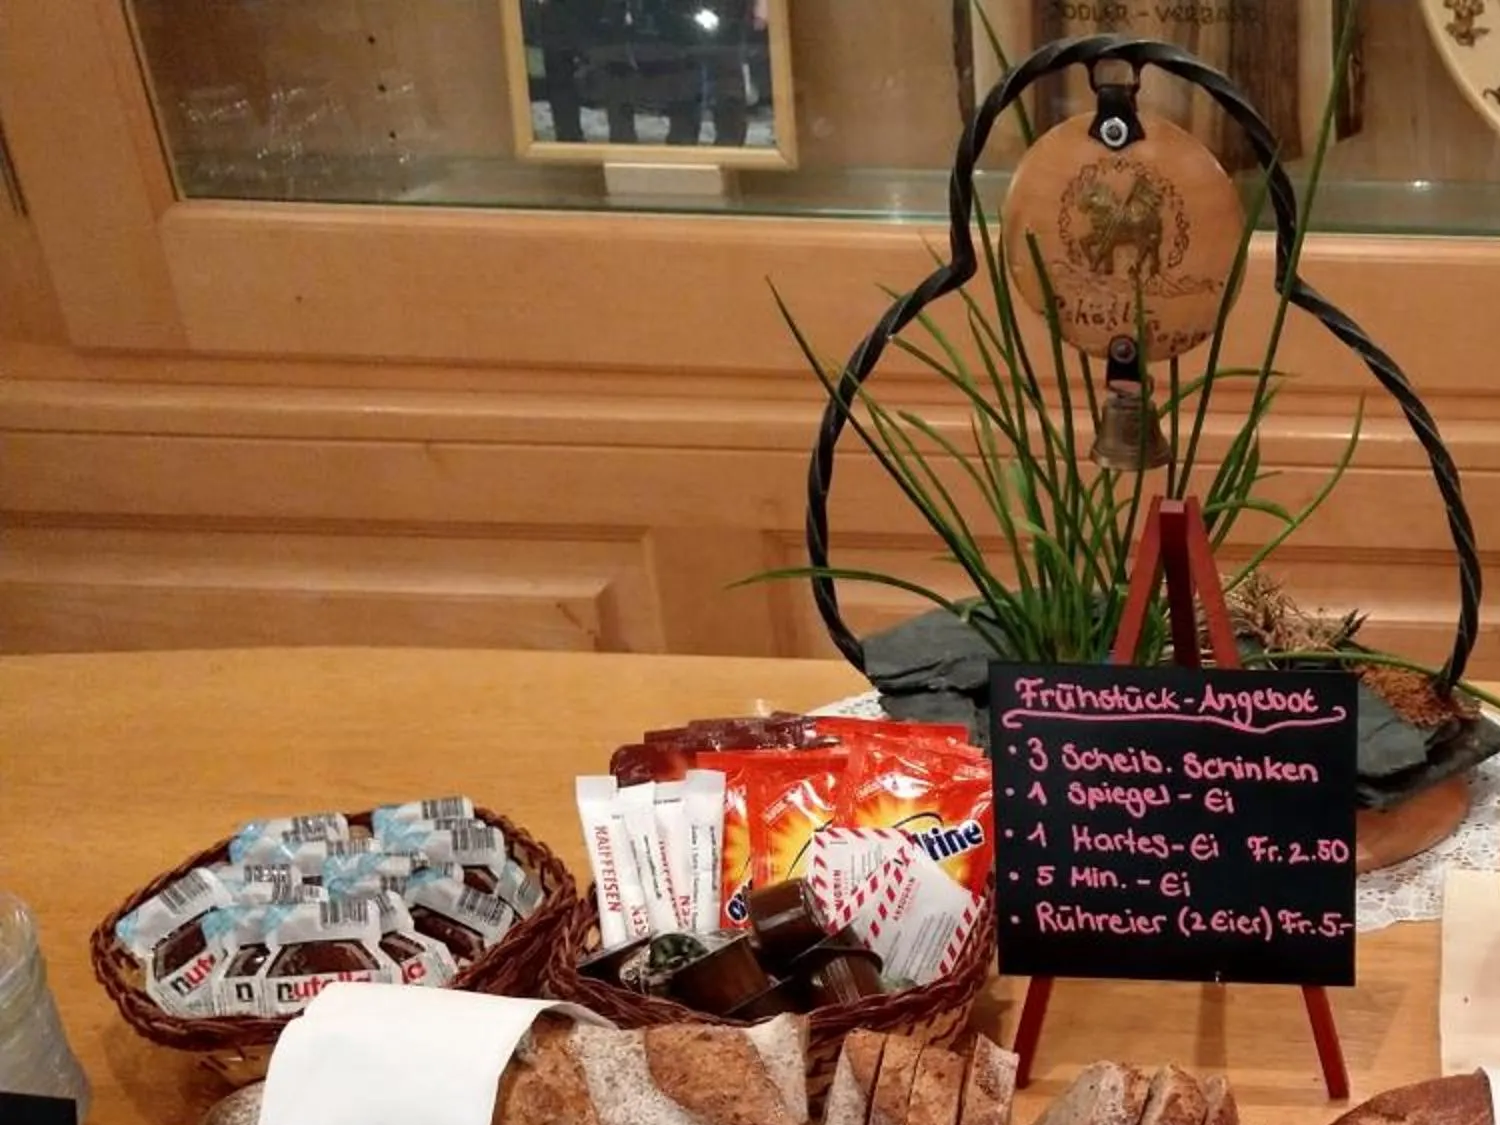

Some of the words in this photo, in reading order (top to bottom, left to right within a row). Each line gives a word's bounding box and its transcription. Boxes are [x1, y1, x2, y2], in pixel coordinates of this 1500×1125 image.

[1027, 737, 1048, 772] 3
[1061, 743, 1172, 774] Scheib.
[1183, 751, 1319, 783] Schinken
[1027, 781, 1047, 806] 1
[1027, 822, 1047, 847] 1
[1036, 865, 1055, 886] 5
[1036, 901, 1167, 934] Rühreier
